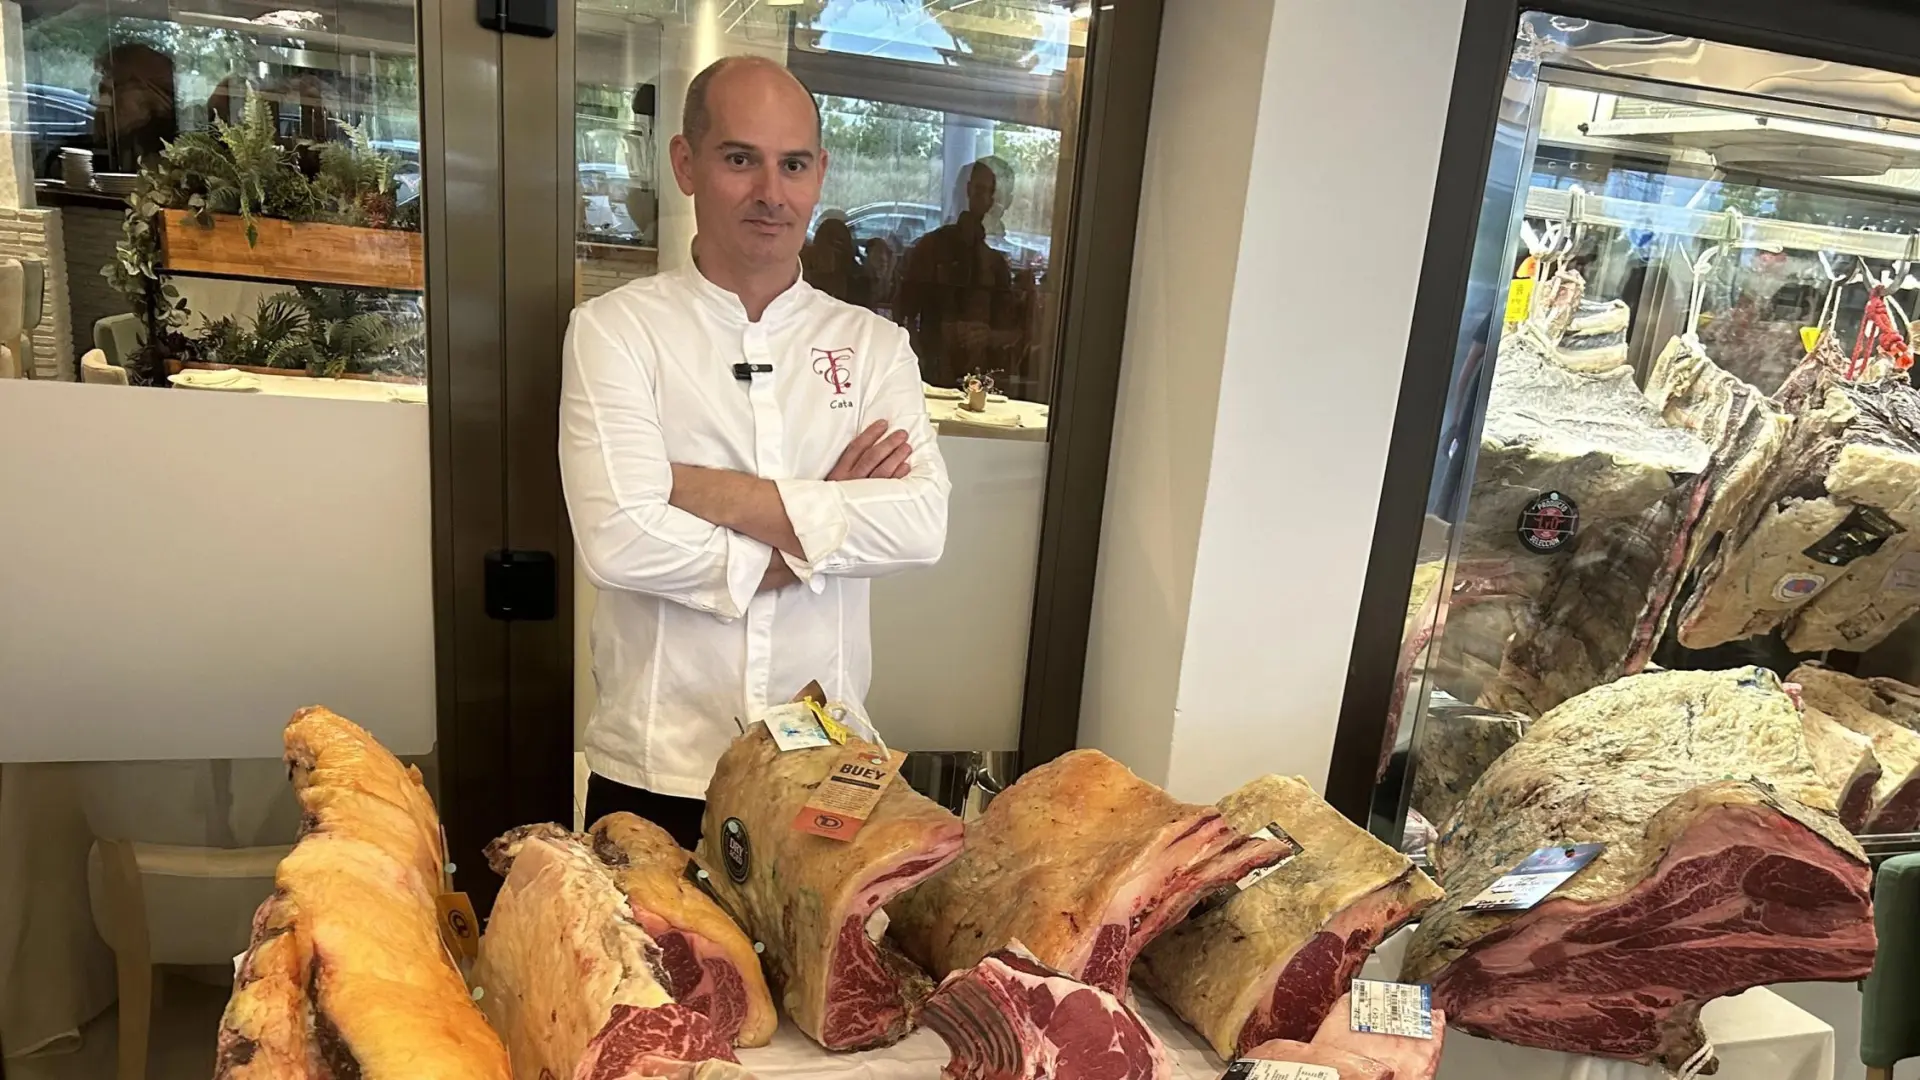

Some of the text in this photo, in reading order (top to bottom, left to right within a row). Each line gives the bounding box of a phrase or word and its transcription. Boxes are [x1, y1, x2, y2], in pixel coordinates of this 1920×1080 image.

[829, 399, 854, 410] Cata
[839, 763, 887, 780] BUEY
[729, 837, 744, 857] DRY
